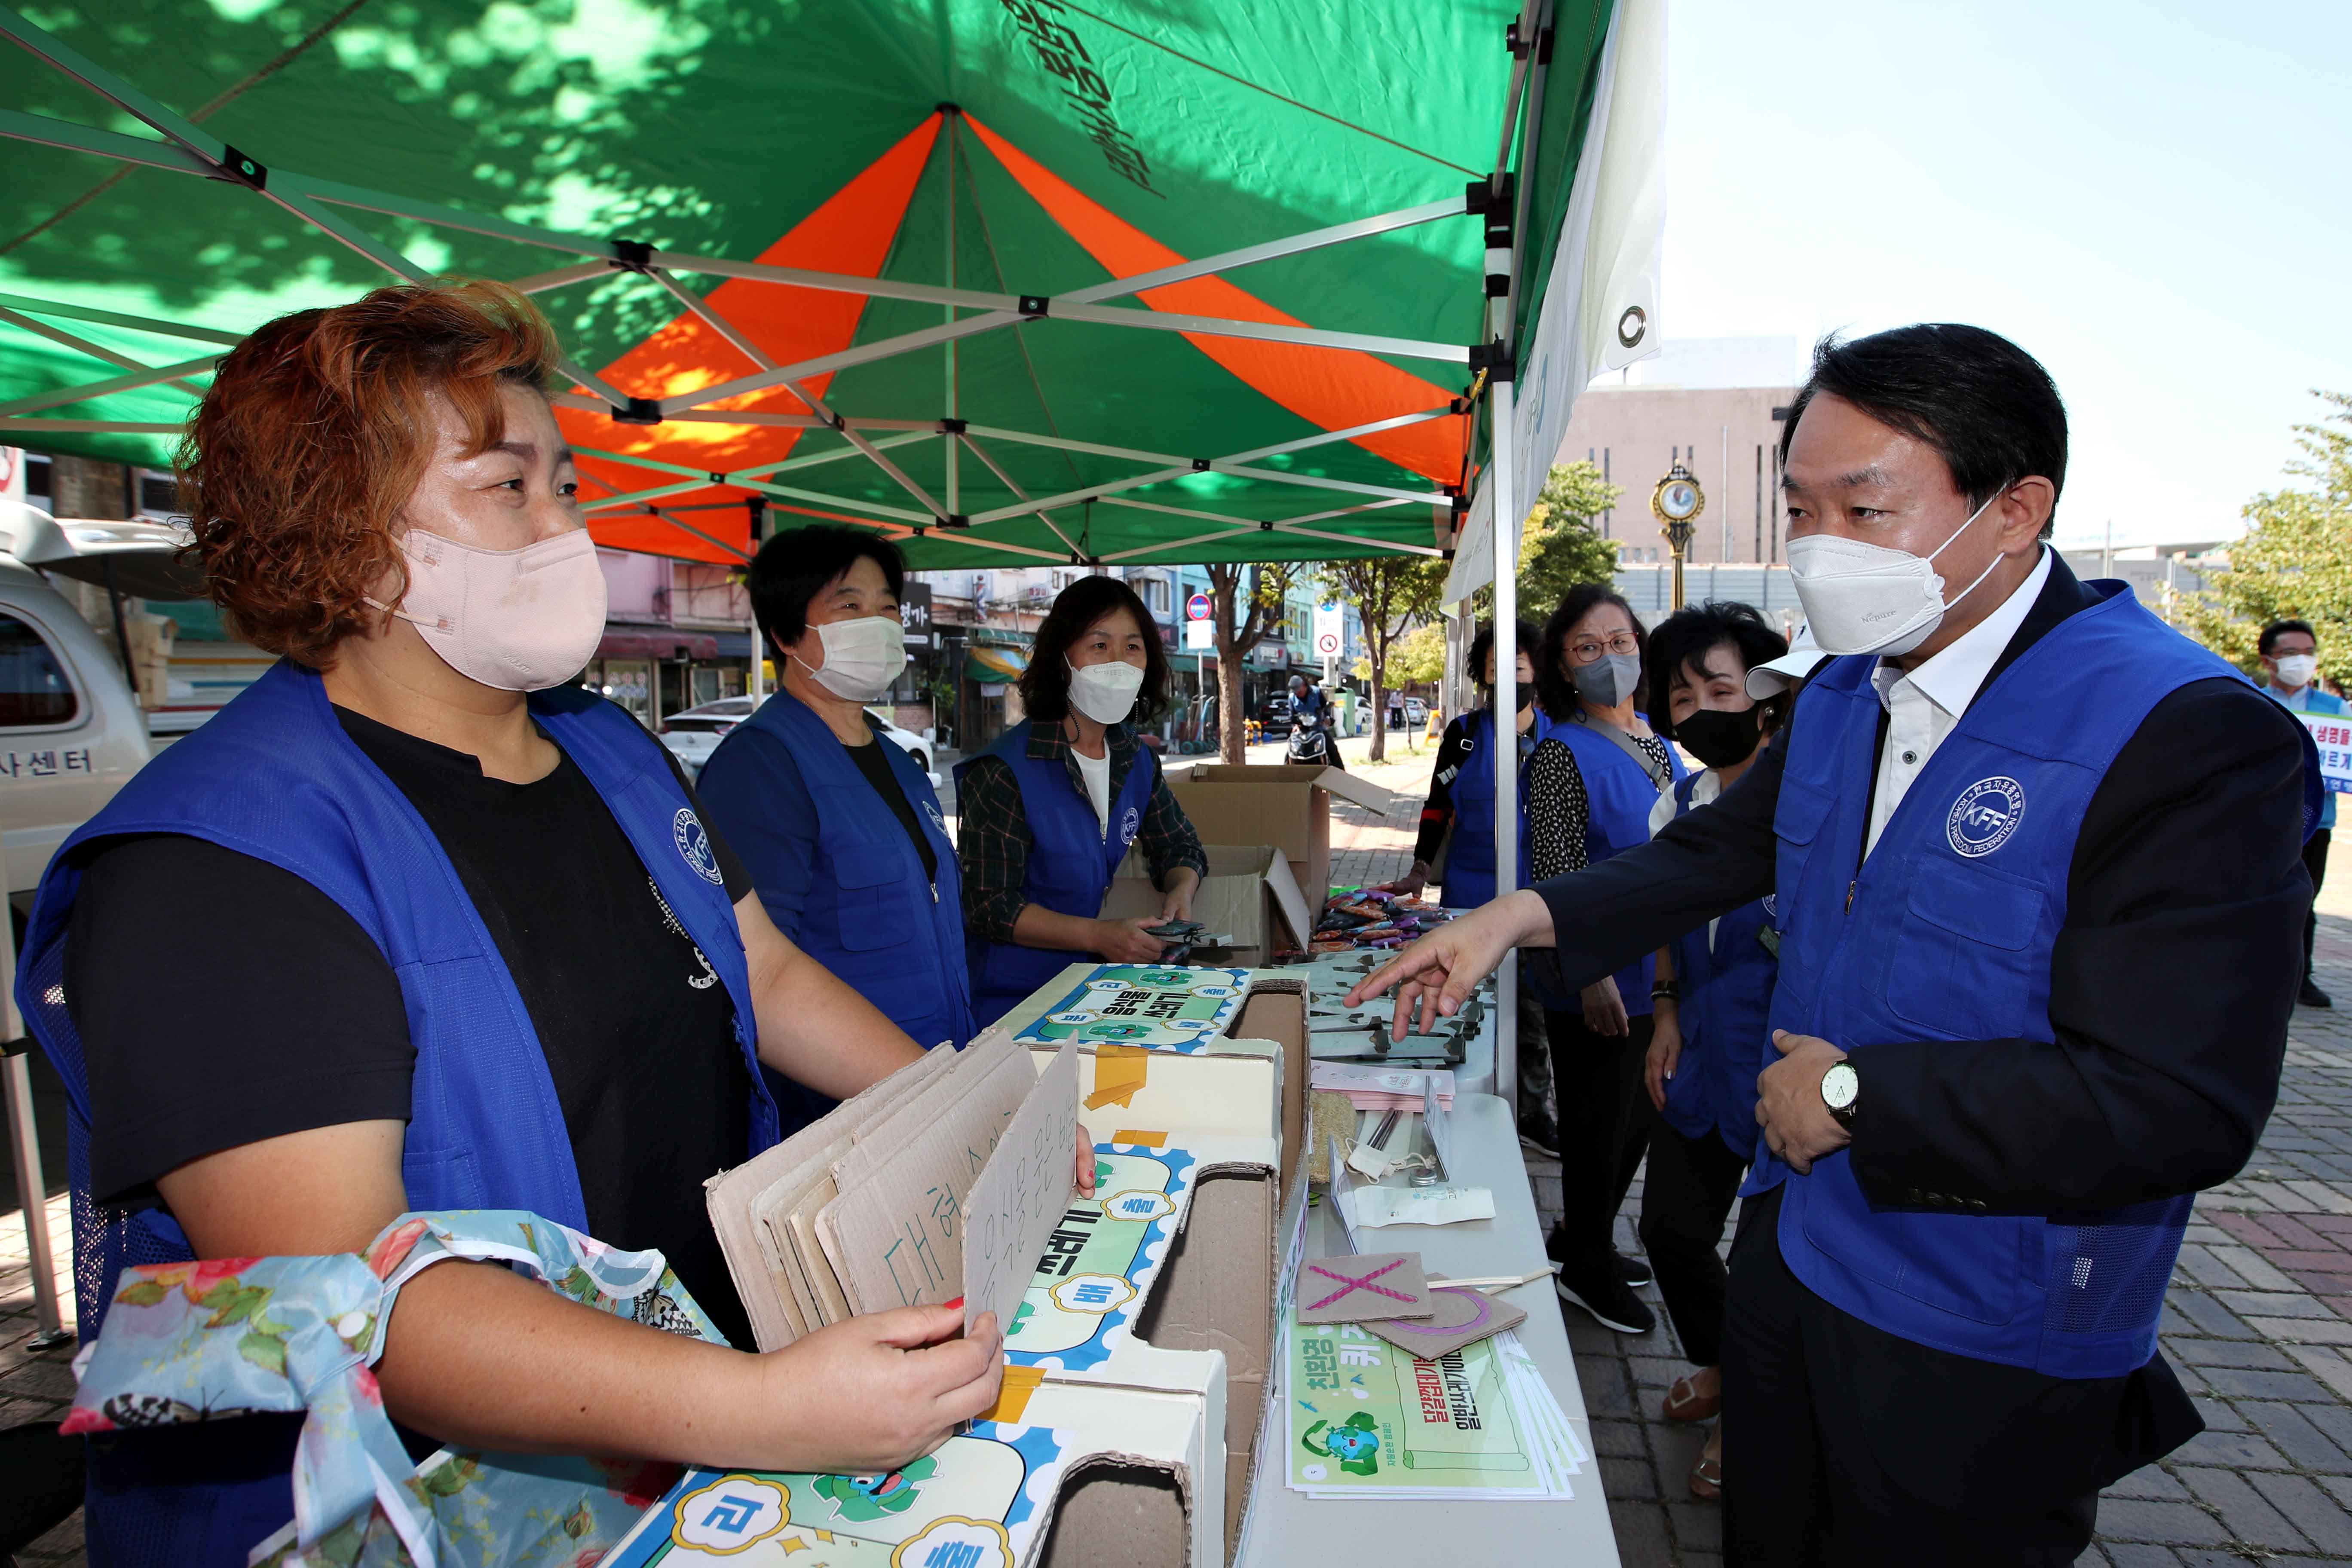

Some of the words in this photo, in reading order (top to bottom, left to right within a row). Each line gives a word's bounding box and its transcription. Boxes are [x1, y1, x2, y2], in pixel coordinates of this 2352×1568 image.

[1974, 780, 2021, 809] 한국자유총연맹
[1951, 798, 1968, 825] KOREA
[1961, 802, 2008, 831] KFF
[1950, 825, 1972, 853] FREEDOM
[1973, 818, 2017, 853] FEDERATION
[1102, 990, 1153, 1016] 음식물
[1142, 992, 1191, 1019] 쓰레기
[1072, 1283, 1114, 1304] 배
[1121, 1198, 1156, 1214] 출
[1301, 1338, 1340, 1390] 친환경
[700, 1494, 765, 1534] 리
